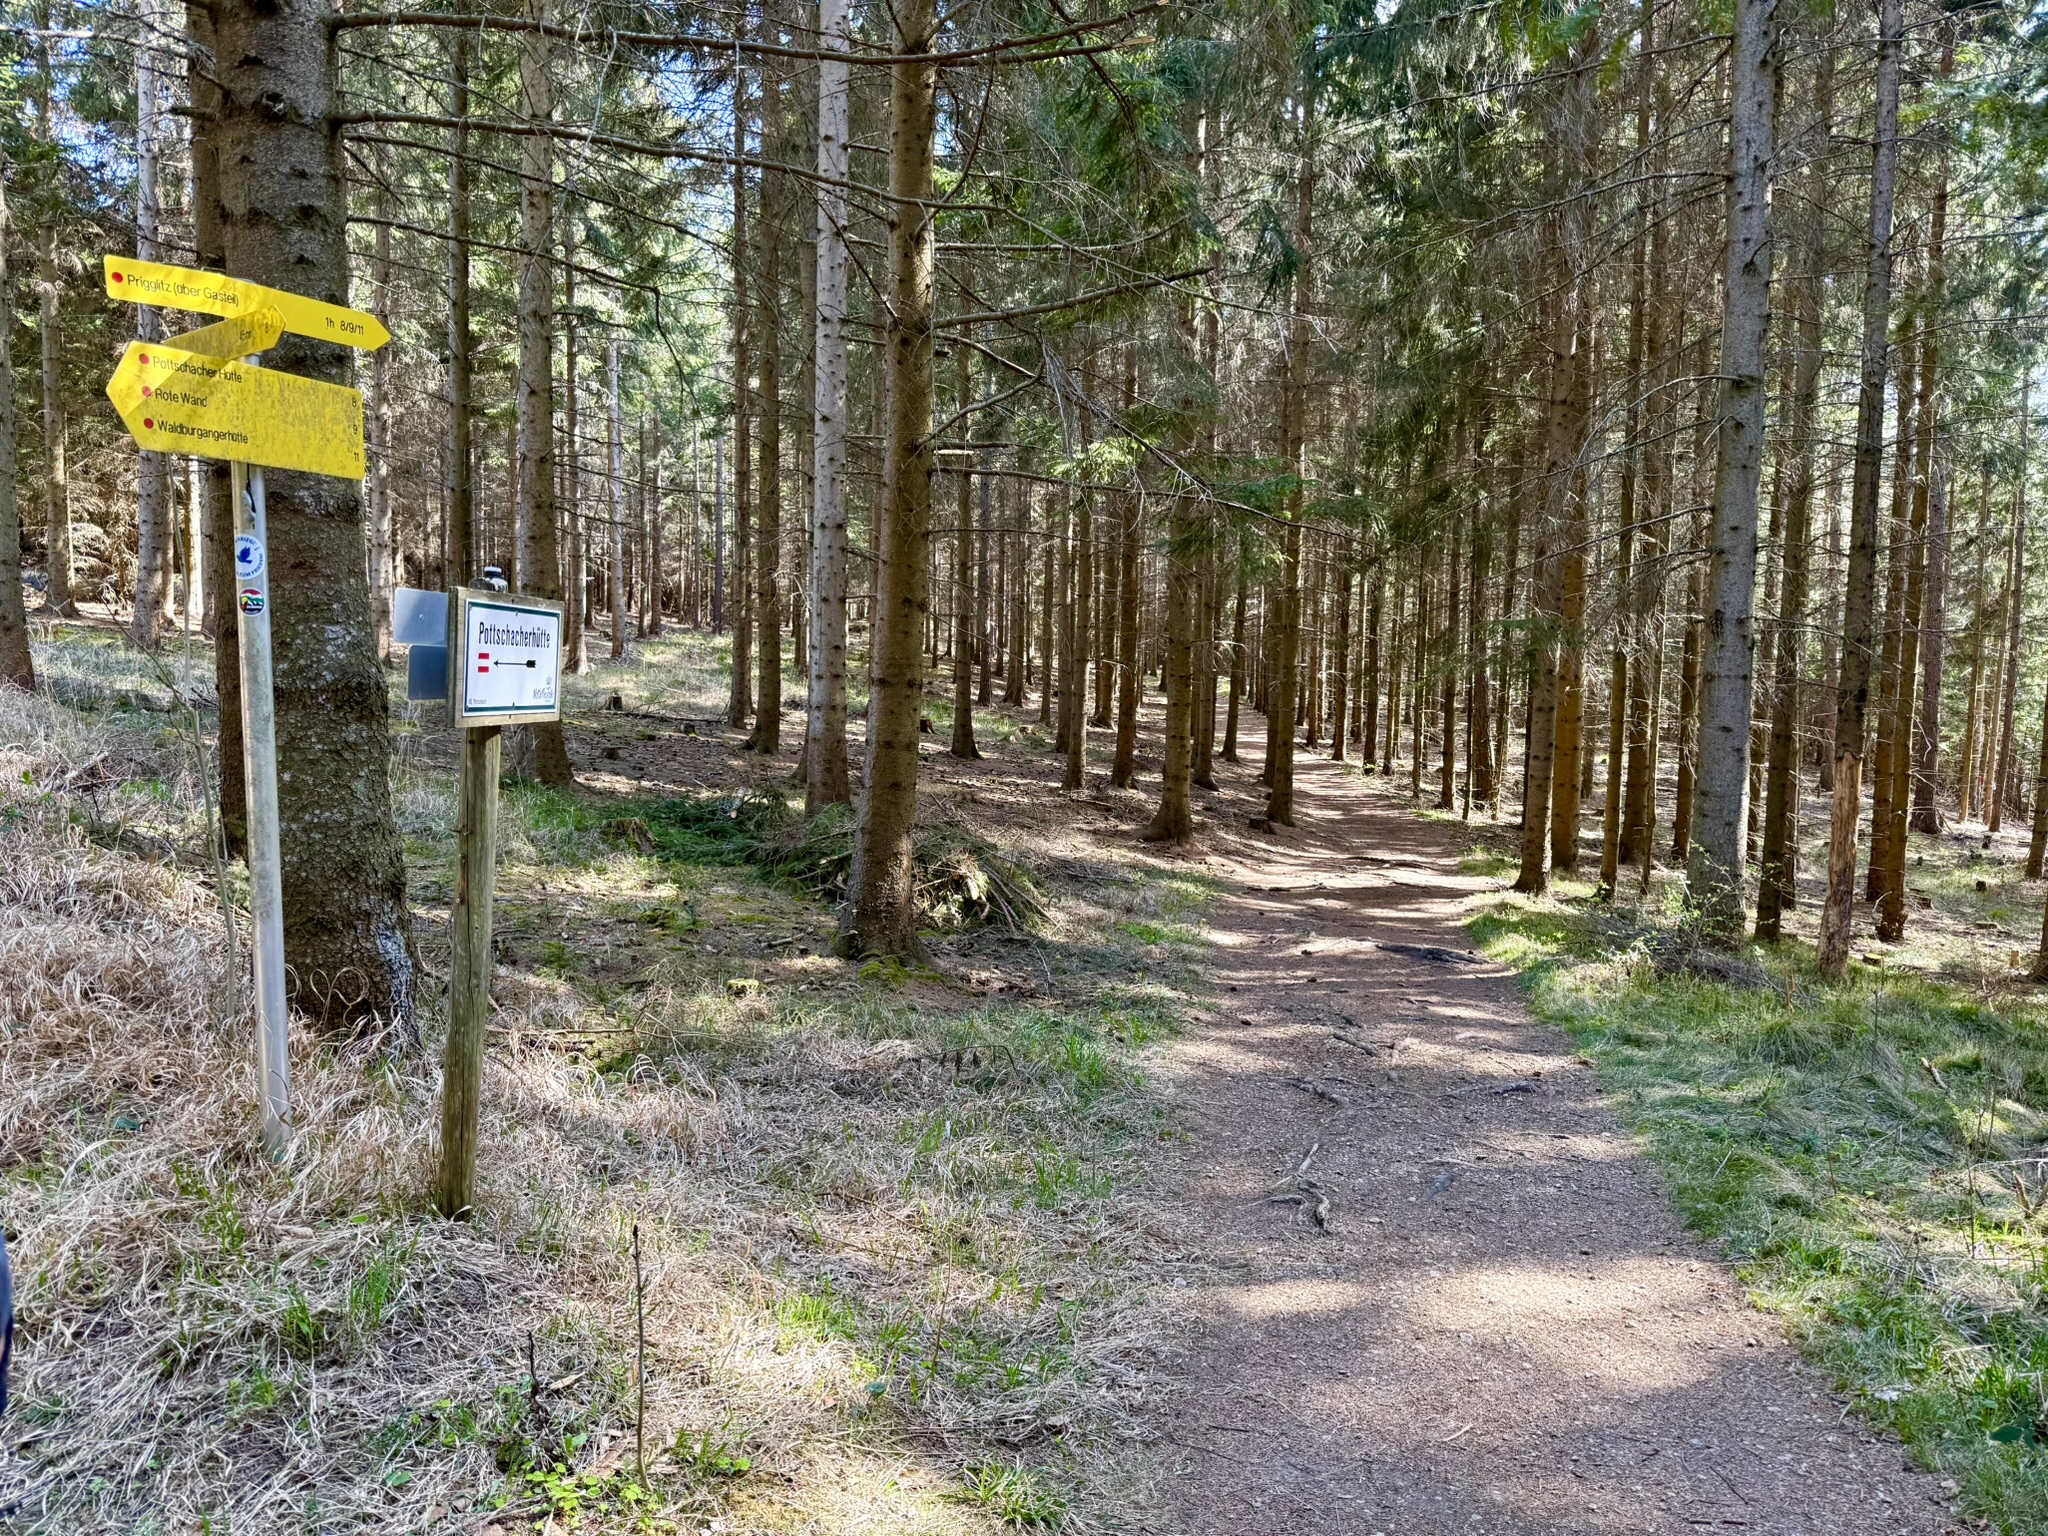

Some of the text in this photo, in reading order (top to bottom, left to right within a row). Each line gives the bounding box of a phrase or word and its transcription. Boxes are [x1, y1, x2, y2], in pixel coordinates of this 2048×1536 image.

[127, 274, 172, 293] Prigglitz
[325, 316, 365, 336] 1h 8/9/11
[152, 355, 217, 378] Pottschacher
[352, 397, 357, 408] 8
[155, 387, 358, 435] Rote Wand 9
[353, 451, 360, 462] 11
[478, 621, 551, 649] Pottschacherhütte
